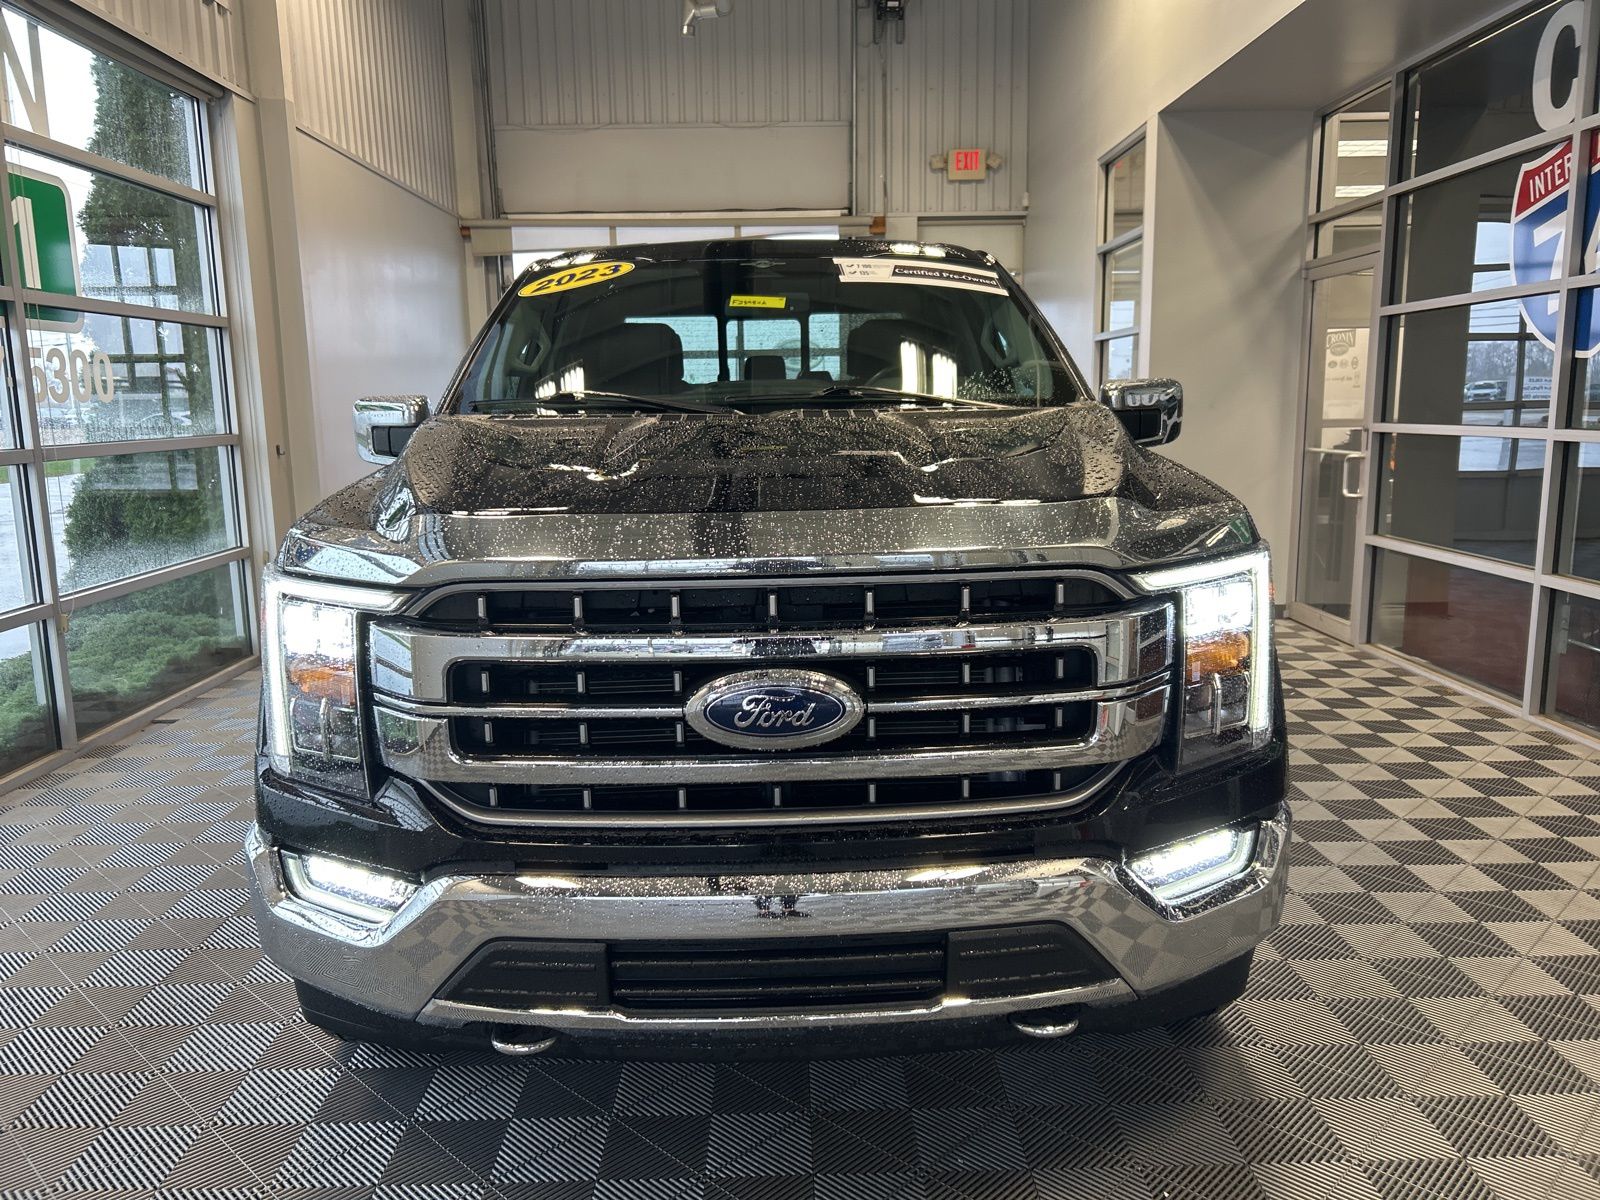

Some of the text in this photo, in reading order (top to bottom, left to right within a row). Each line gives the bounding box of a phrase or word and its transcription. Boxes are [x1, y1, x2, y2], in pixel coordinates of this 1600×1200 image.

[955, 151, 979, 170] EXIT
[530, 264, 622, 294] 2023
[894, 268, 998, 286] Certified Pre-Owned
[734, 694, 815, 728] Ford
